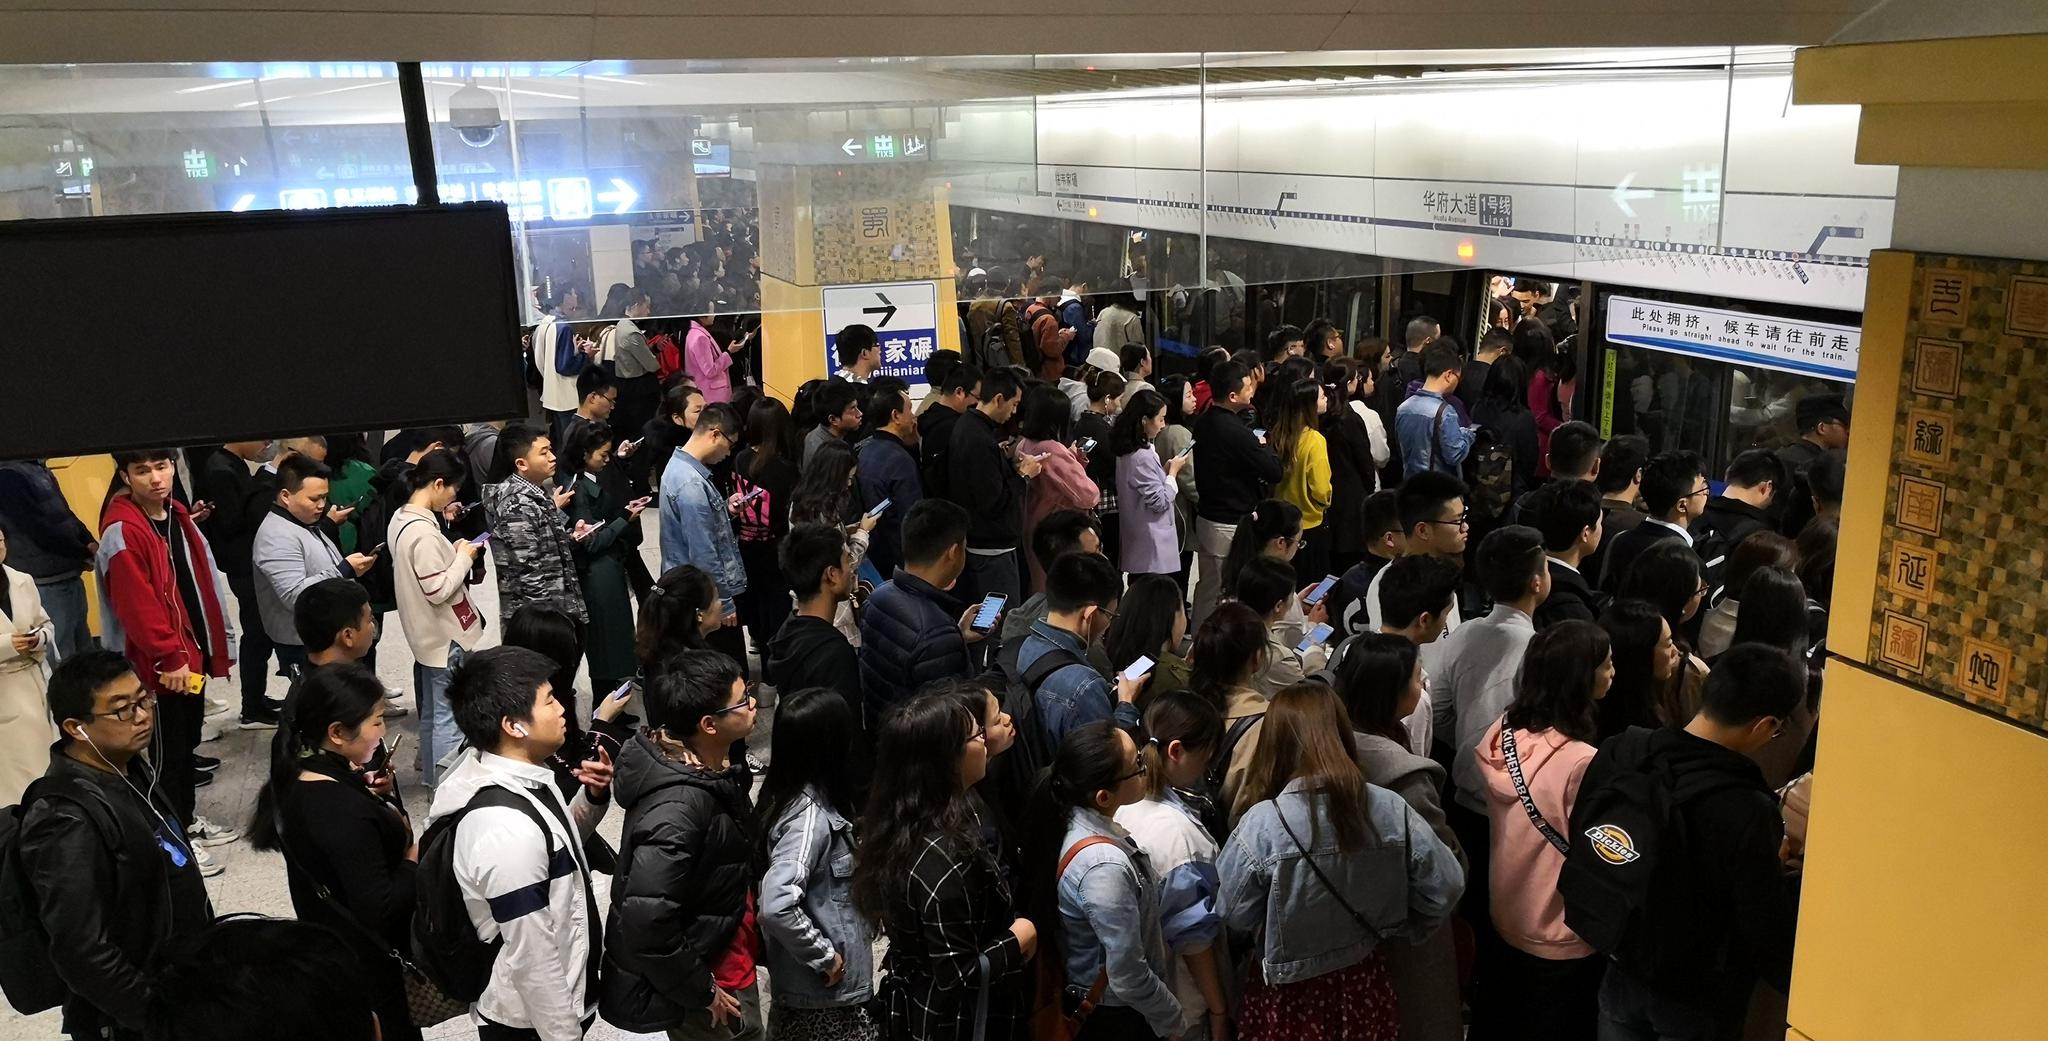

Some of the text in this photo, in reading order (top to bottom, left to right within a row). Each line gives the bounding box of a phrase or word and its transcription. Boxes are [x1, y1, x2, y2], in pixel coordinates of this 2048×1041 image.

[1423, 190, 1477, 216] 华府大道
[1480, 196, 1511, 216] 1号线
[1482, 214, 1510, 226] Line1
[1642, 323, 1846, 362] Please go straight ahead to wait for the train.
[1591, 829, 1636, 860] Dickies
